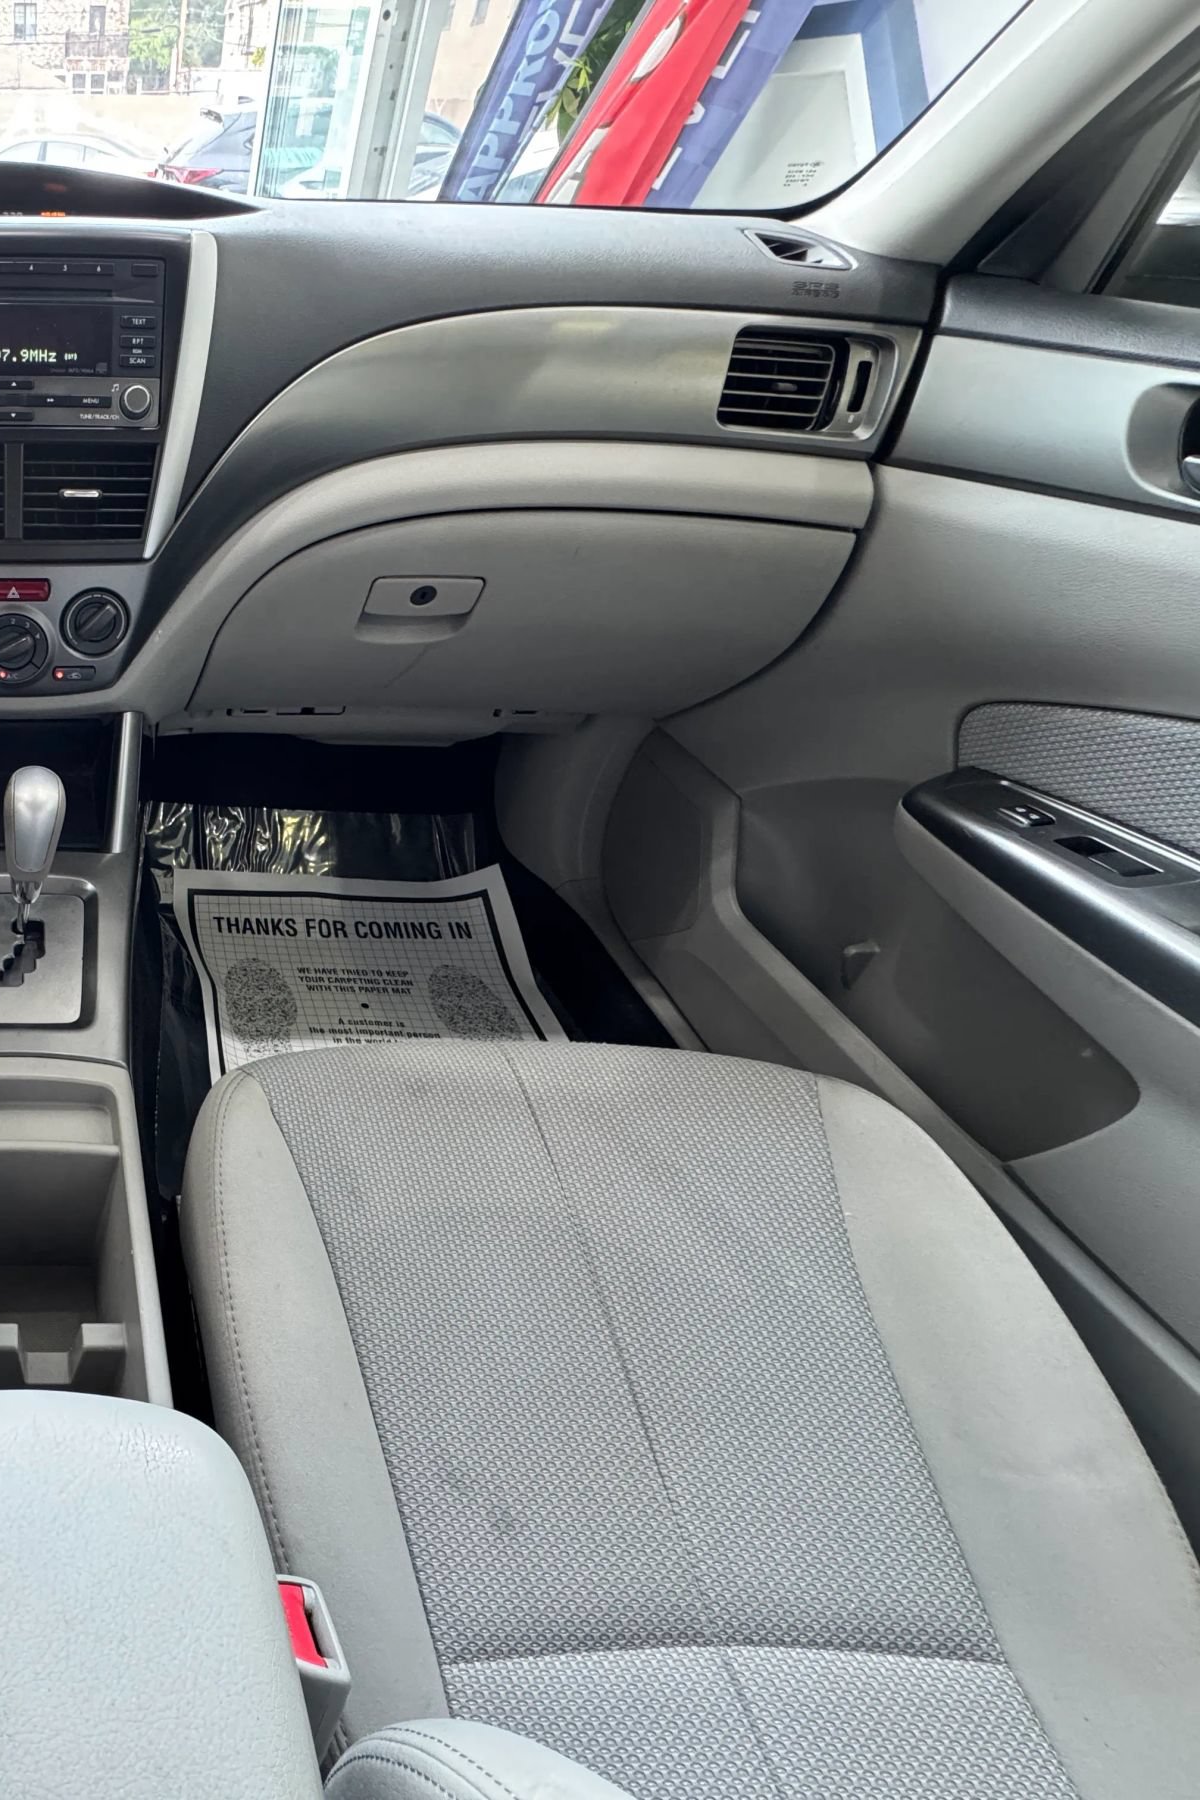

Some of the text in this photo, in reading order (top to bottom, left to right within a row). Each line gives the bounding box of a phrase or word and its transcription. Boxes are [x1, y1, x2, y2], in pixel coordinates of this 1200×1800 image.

[128, 357, 146, 365] SCAN
[11, 618, 16, 626] 2
[213, 916, 473, 939] THANKS FOR COMING IN
[297, 967, 312, 975] WE
[370, 969, 383, 977] TO
[327, 977, 380, 985] CARPETING
[383, 978, 414, 986] CLEAN
[358, 986, 389, 994] PAPER
[338, 1017, 405, 1028] A customer is
[328, 1027, 353, 1035] most
[355, 1027, 404, 1037] important
[406, 1031, 441, 1039] person
